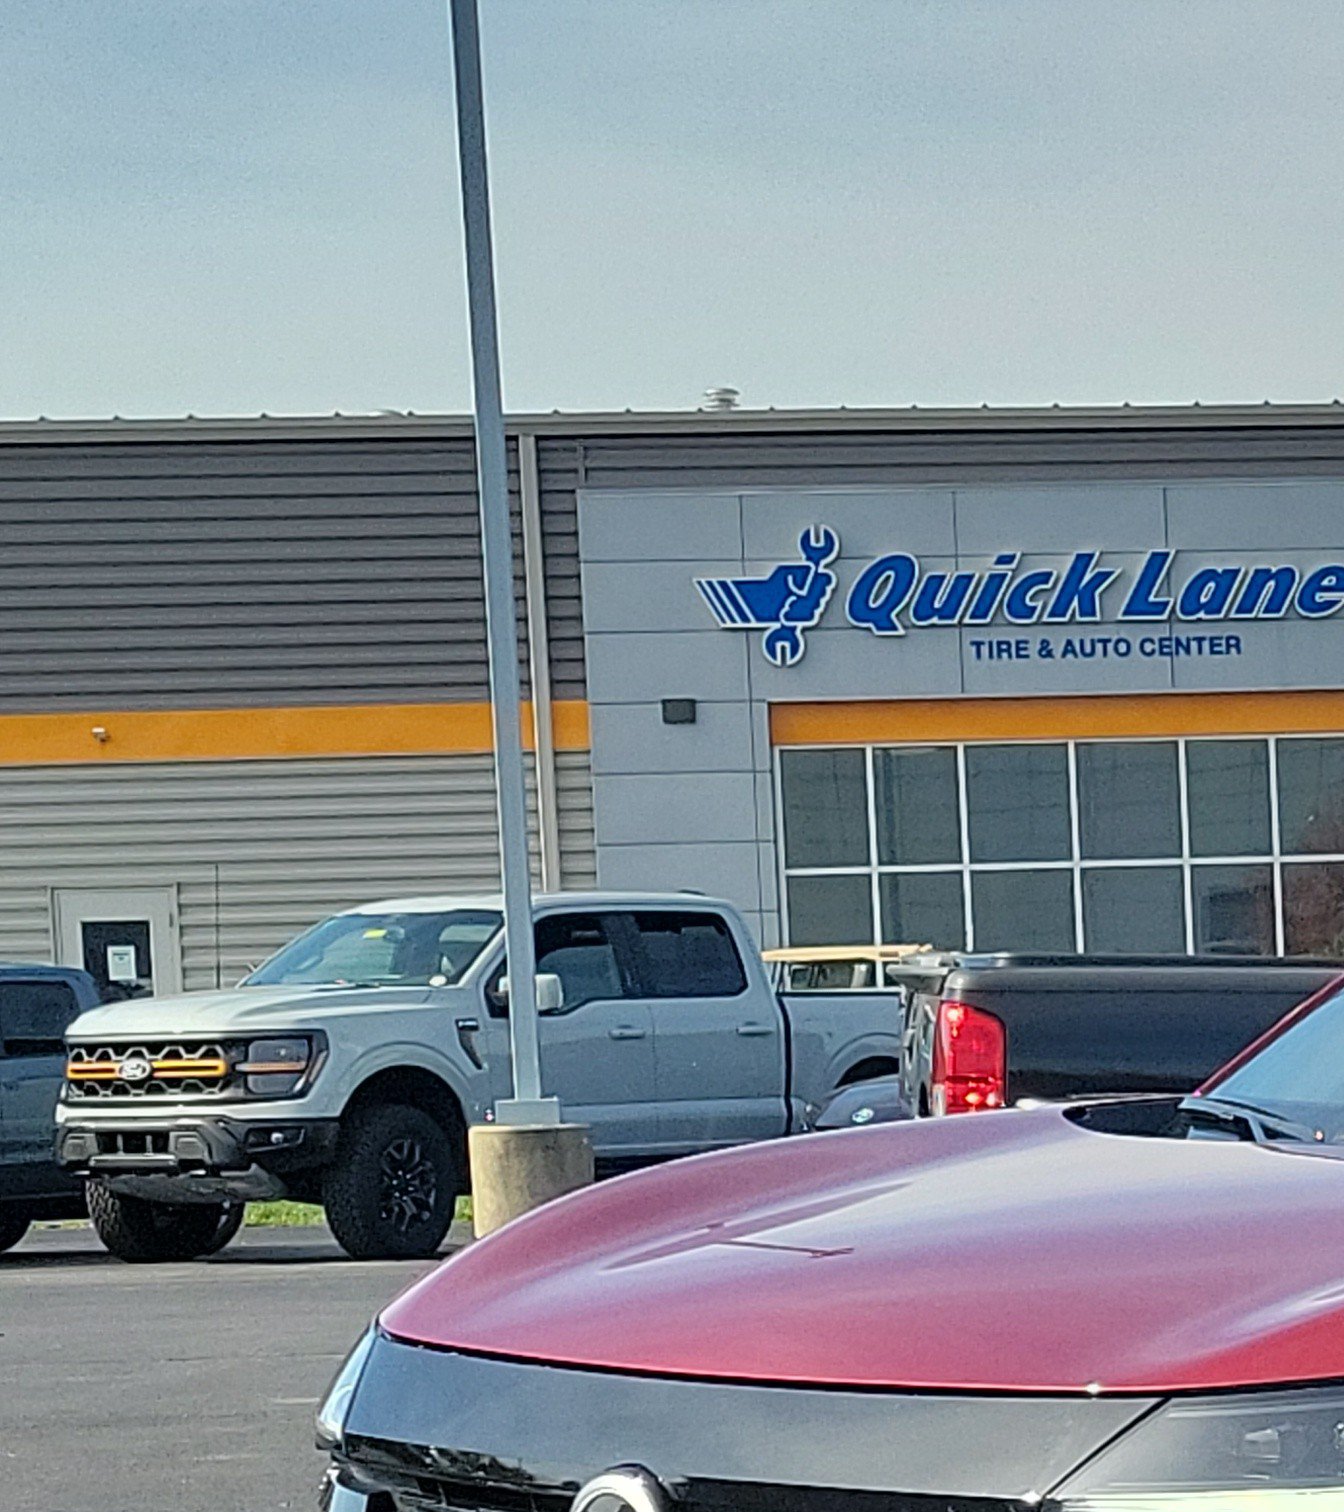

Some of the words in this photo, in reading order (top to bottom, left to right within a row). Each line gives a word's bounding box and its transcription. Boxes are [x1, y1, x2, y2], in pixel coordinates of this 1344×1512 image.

[847, 549, 1121, 635] Quick
[969, 640, 1031, 660] TIRE
[1037, 638, 1055, 659] &
[1061, 637, 1132, 659] AUTO
[1139, 635, 1242, 657] CENTER
